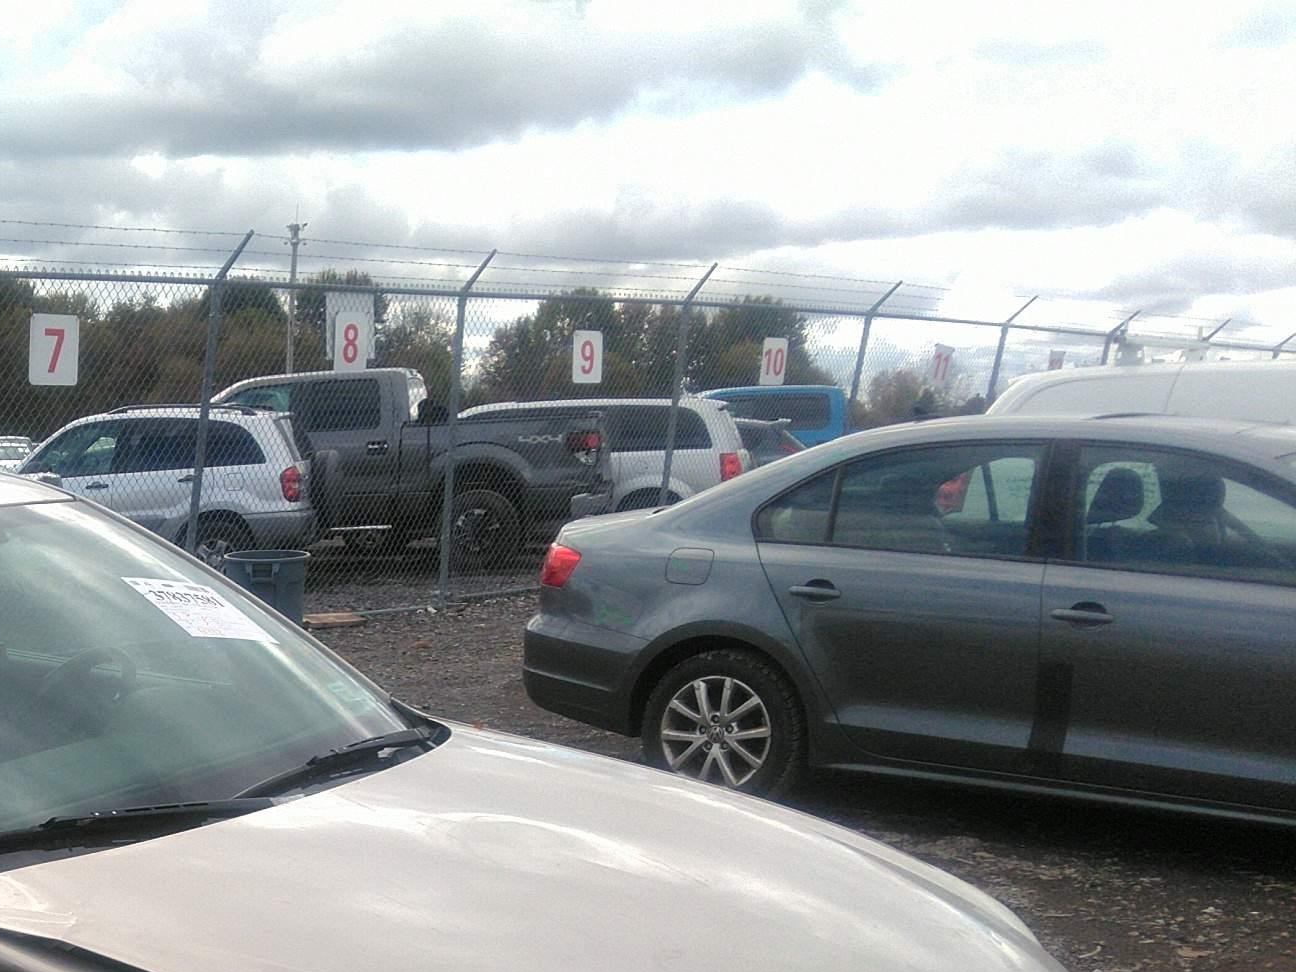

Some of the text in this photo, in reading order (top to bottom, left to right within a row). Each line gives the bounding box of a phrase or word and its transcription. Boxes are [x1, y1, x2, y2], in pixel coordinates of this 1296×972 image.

[44, 327, 65, 374] 7
[343, 323, 359, 364] 8
[580, 340, 594, 375] 9
[764, 347, 785, 377] 10
[934, 352, 953, 381] 11
